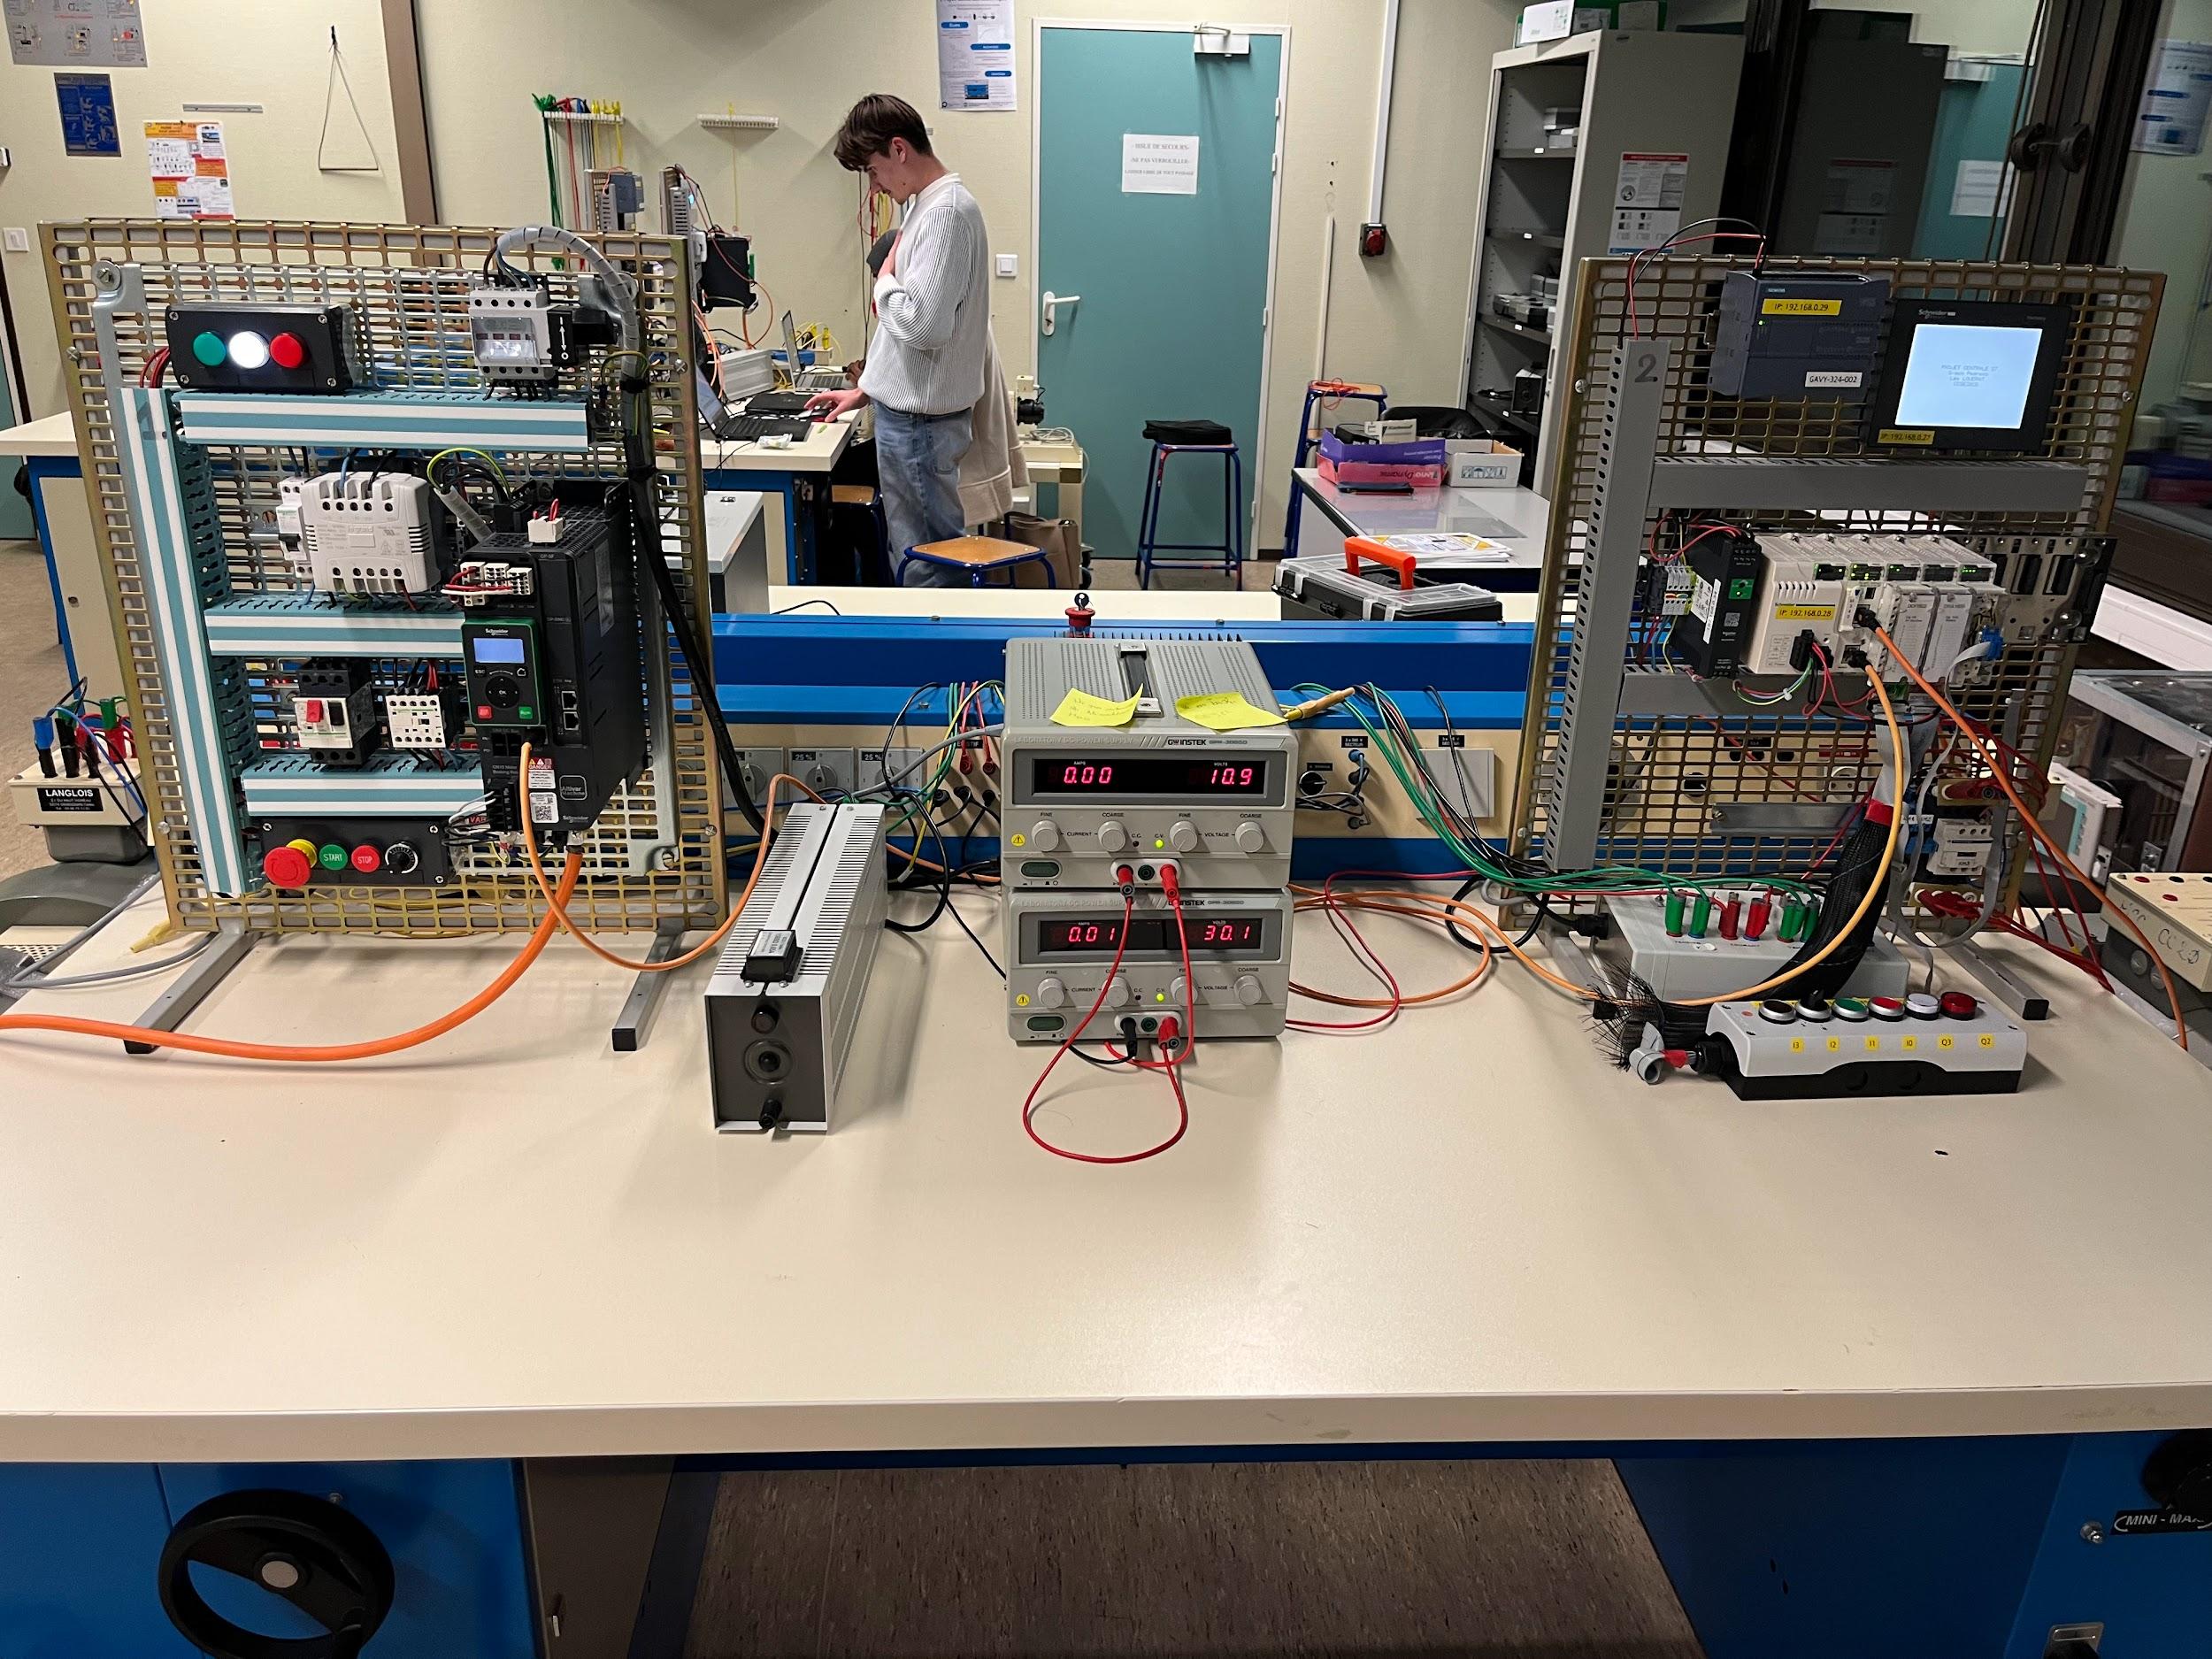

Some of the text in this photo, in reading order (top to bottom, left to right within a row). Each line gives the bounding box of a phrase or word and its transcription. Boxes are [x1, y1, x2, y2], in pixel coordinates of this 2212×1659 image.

[1634, 354, 1658, 382] 2
[1064, 766, 1112, 784] 0.00
[1210, 768, 1253, 785] 10.9
[1068, 926, 1116, 942] 0.01
[1204, 925, 1250, 941] 30.1
[2125, 1514, 2158, 1525] MINI
